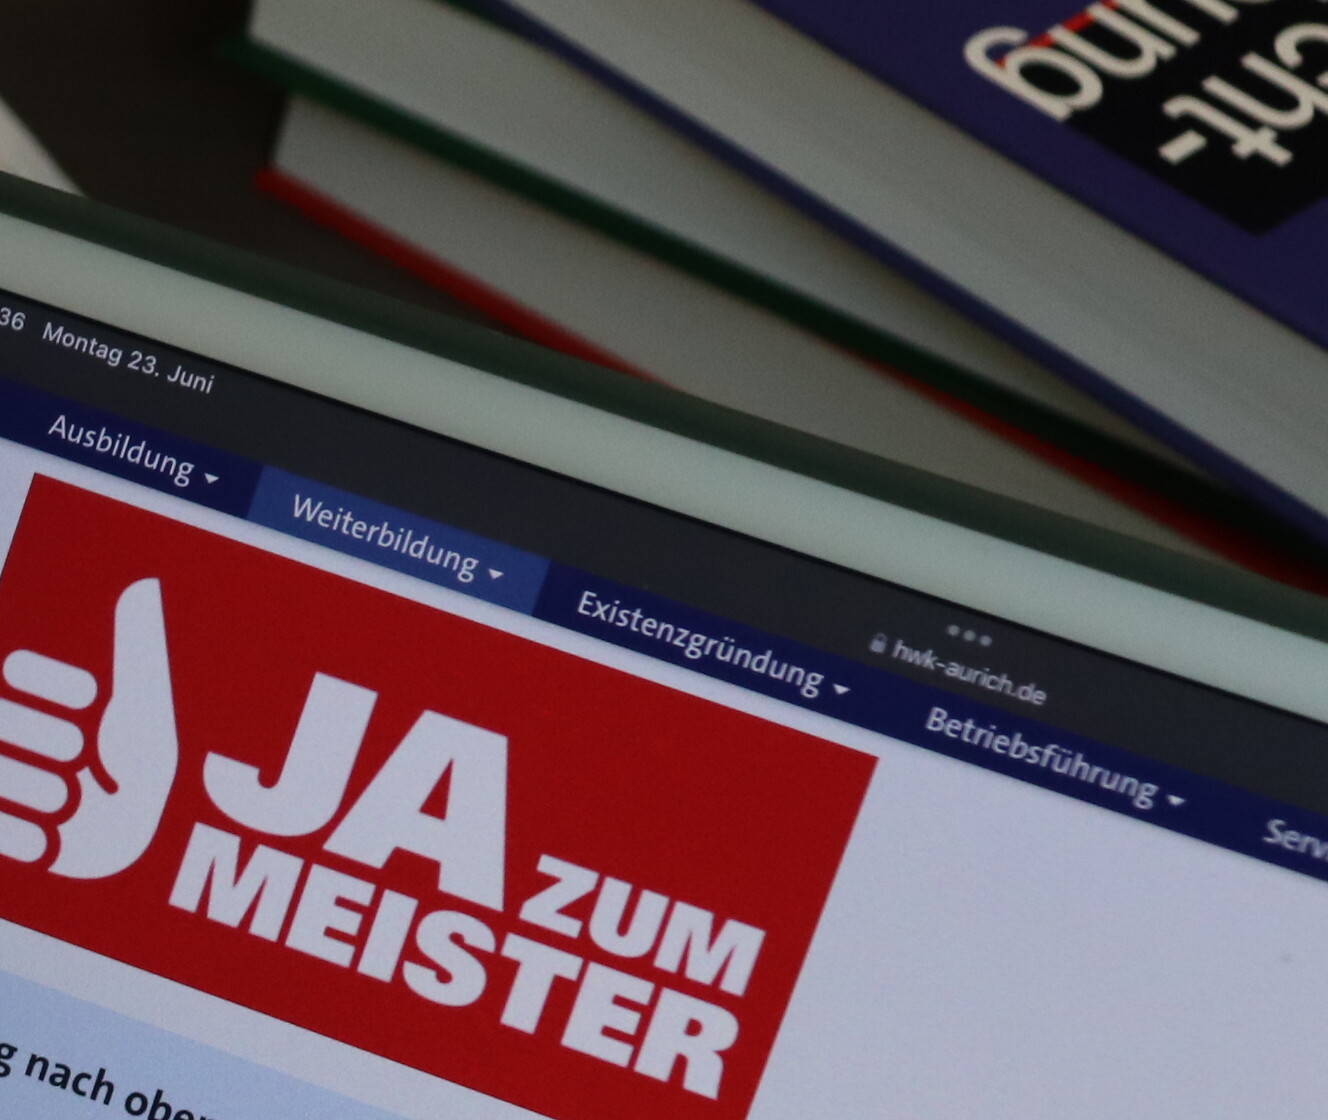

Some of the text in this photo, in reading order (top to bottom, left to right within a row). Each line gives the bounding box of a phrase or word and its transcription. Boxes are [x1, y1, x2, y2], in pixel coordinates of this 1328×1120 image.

[41, 321, 123, 367] Montag
[126, 349, 159, 377] 23.
[166, 364, 215, 394] Juni
[47, 413, 194, 488] Ausbildung
[292, 493, 479, 583] Weiterbildung
[576, 590, 824, 699] Existenzgründung
[925, 706, 1158, 810] Betriebsführung
[892, 639, 1047, 705] hwk-aurich.de
[202, 671, 766, 997] JA ZUM
[168, 821, 740, 1100] MEISTER
[24, 1052, 115, 1106] nach
